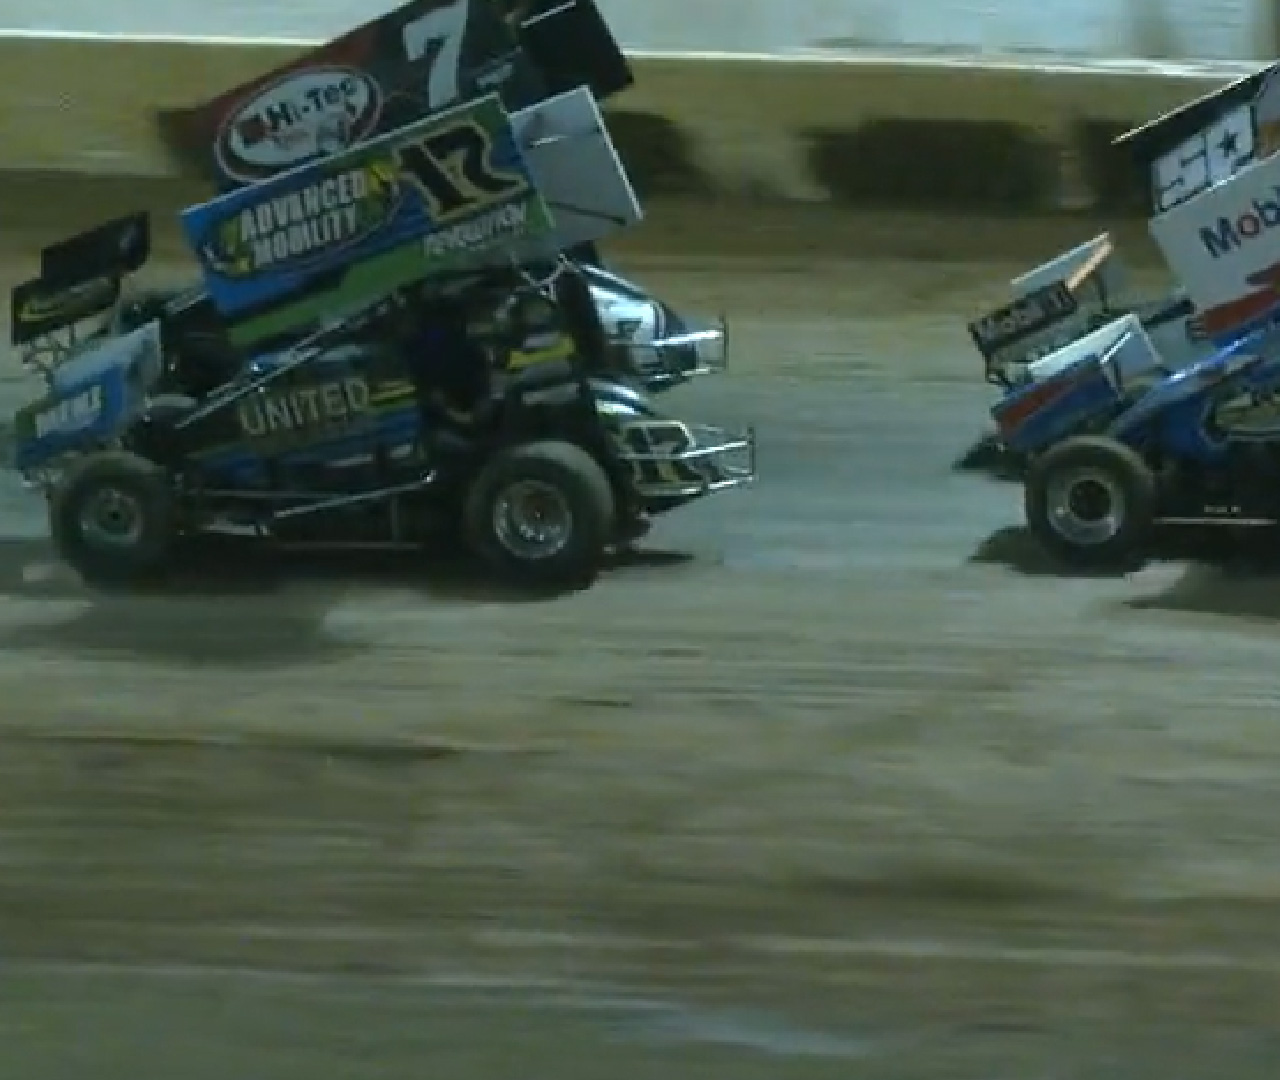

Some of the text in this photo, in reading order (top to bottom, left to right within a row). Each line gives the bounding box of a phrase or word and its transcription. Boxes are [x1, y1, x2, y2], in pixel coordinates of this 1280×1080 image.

[240, 168, 368, 243] ADVANCED
[394, 122, 529, 222] 17
[253, 207, 358, 269] MOBILITY
[238, 377, 369, 436] UNITED
